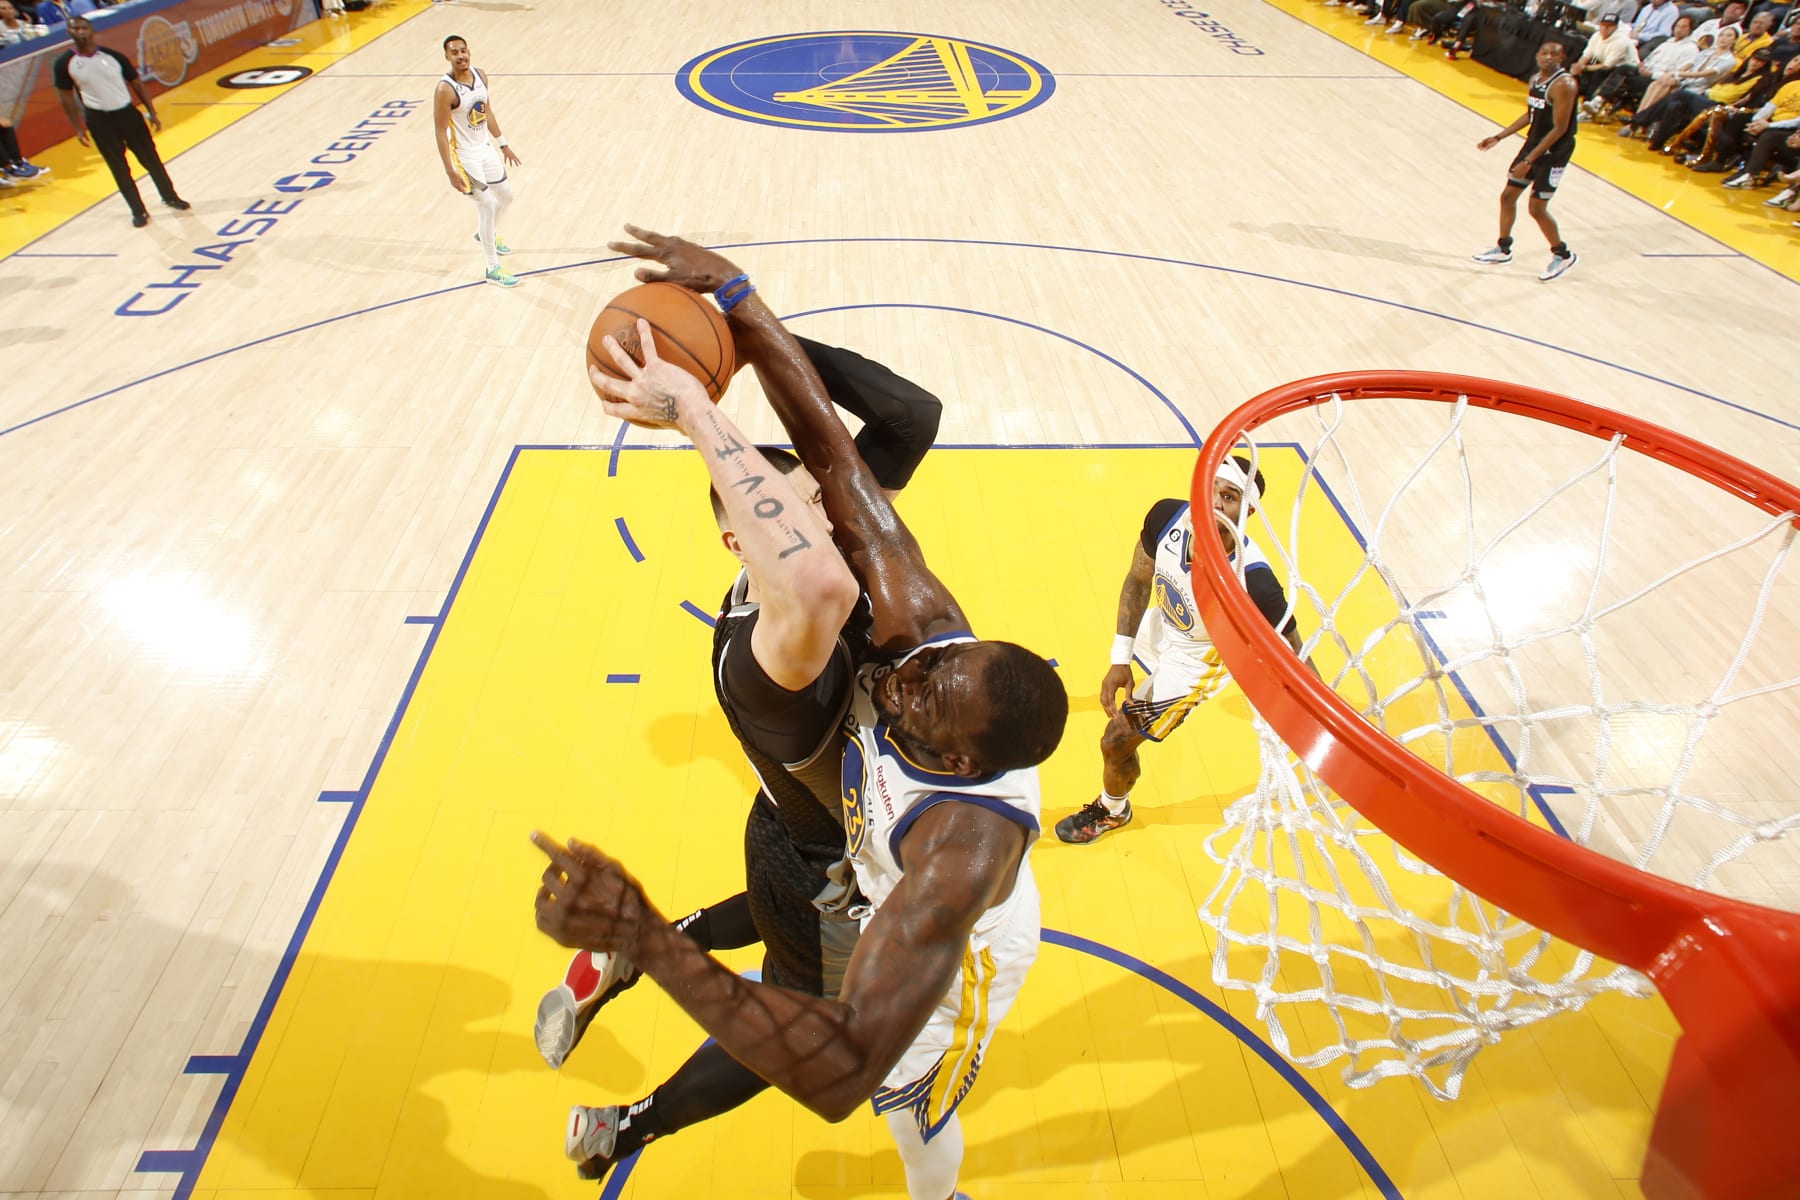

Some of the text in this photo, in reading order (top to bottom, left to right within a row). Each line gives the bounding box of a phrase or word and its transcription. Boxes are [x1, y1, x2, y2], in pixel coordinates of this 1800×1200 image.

[1190, 20, 1265, 55] CHASE
[114, 99, 424, 317] CHASE CENTER
[842, 788, 863, 835] 23
[876, 765, 895, 821] Rakuten
